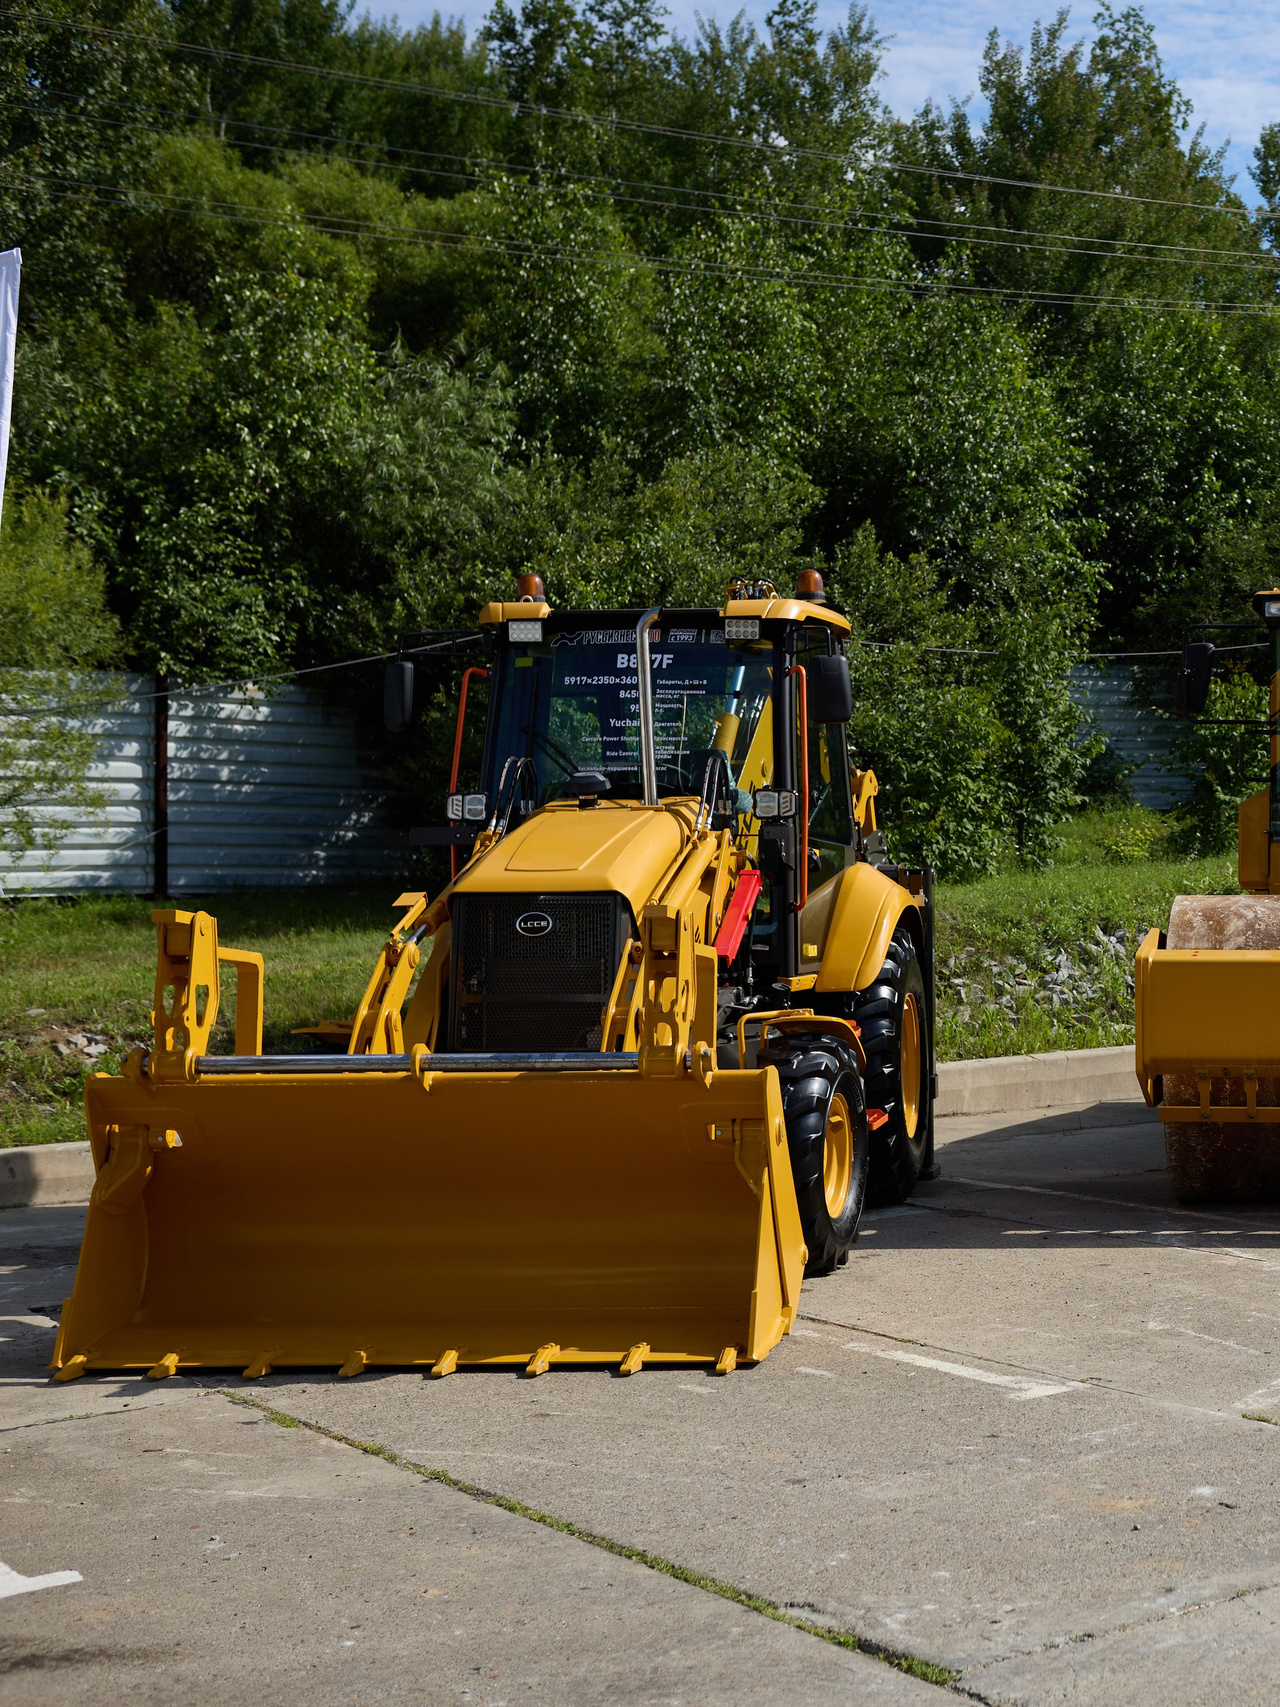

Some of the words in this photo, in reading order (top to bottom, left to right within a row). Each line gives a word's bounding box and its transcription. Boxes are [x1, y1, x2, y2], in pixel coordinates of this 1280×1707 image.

[583, 629, 661, 644] РУСБИЗНЕСТО
[616, 653, 674, 669] B87F
[619, 689, 639, 698] 845
[610, 718, 640, 727] Yuchai
